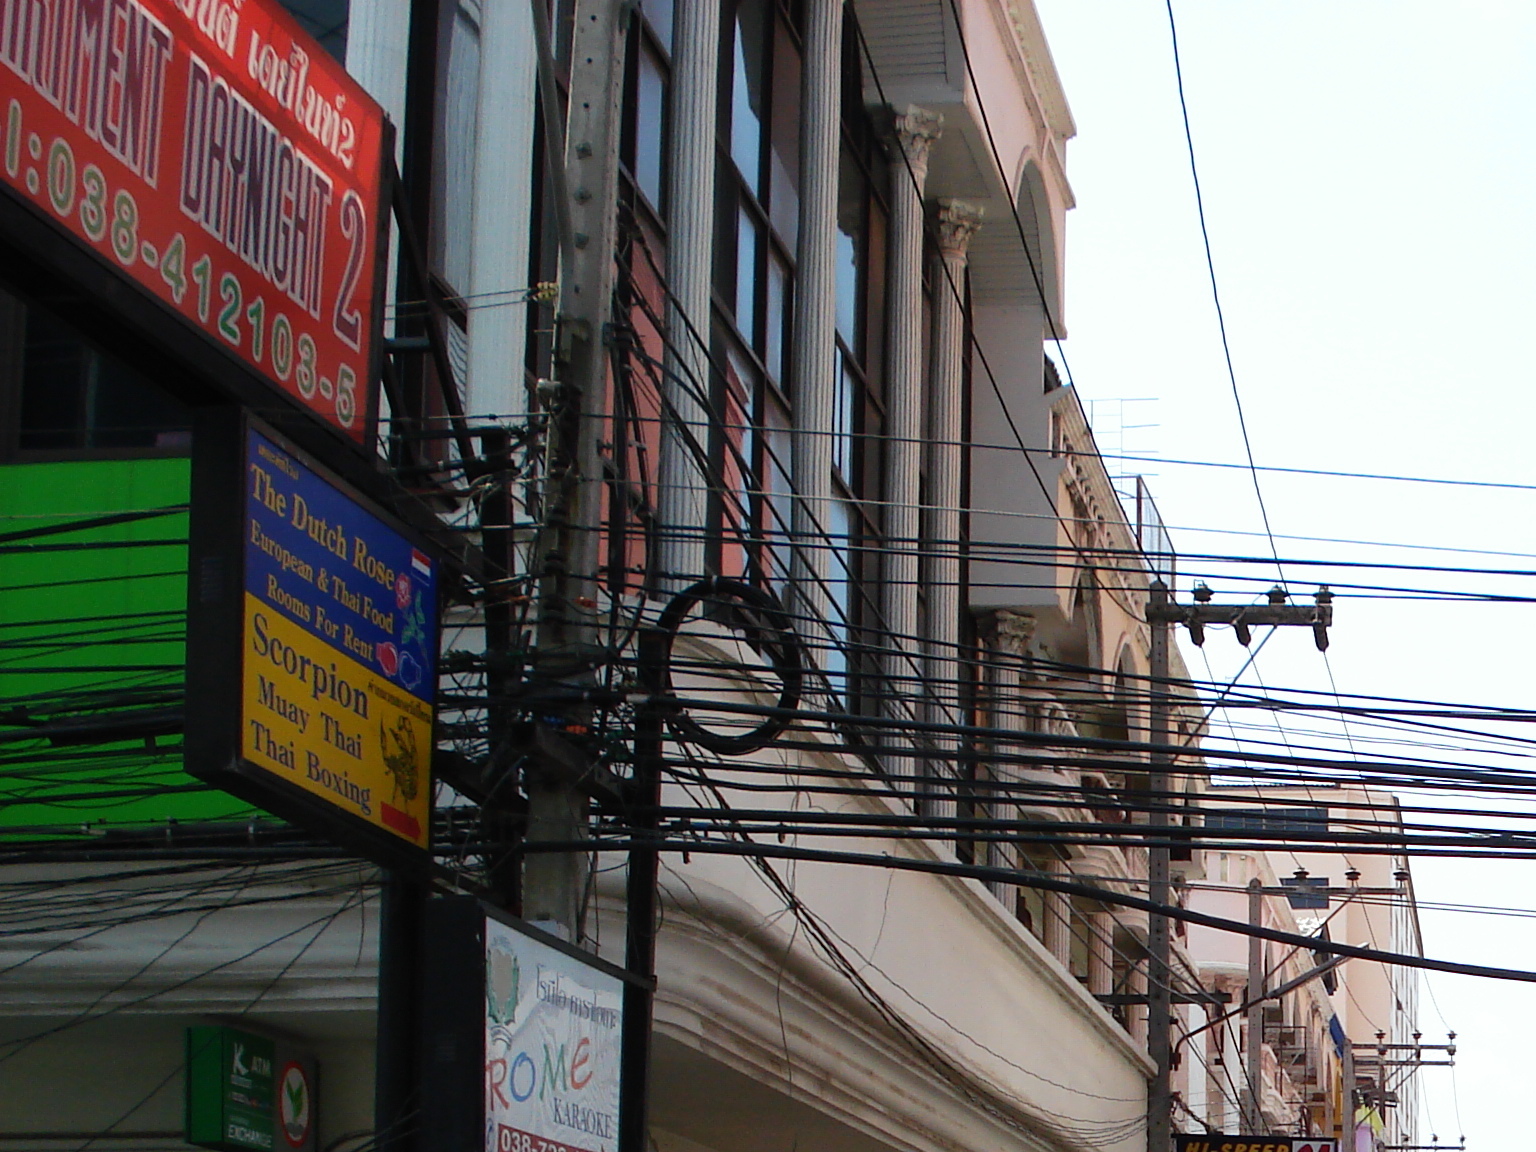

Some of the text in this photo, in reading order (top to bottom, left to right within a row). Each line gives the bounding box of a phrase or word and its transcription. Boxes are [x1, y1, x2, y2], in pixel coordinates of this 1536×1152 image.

[333, 189, 367, 353] 2
[251, 463, 395, 591] The Dutch Rose
[251, 519, 394, 635] European & Thai Food
[267, 573, 374, 662] Rooms For Rent
[253, 612, 370, 720] Scorpion
[258, 674, 311, 735] Muay
[320, 711, 363, 760] Thai
[250, 719, 372, 817] Thai Boxing
[485, 1036, 594, 1113] ROME
[553, 1096, 614, 1140] KARAOKE
